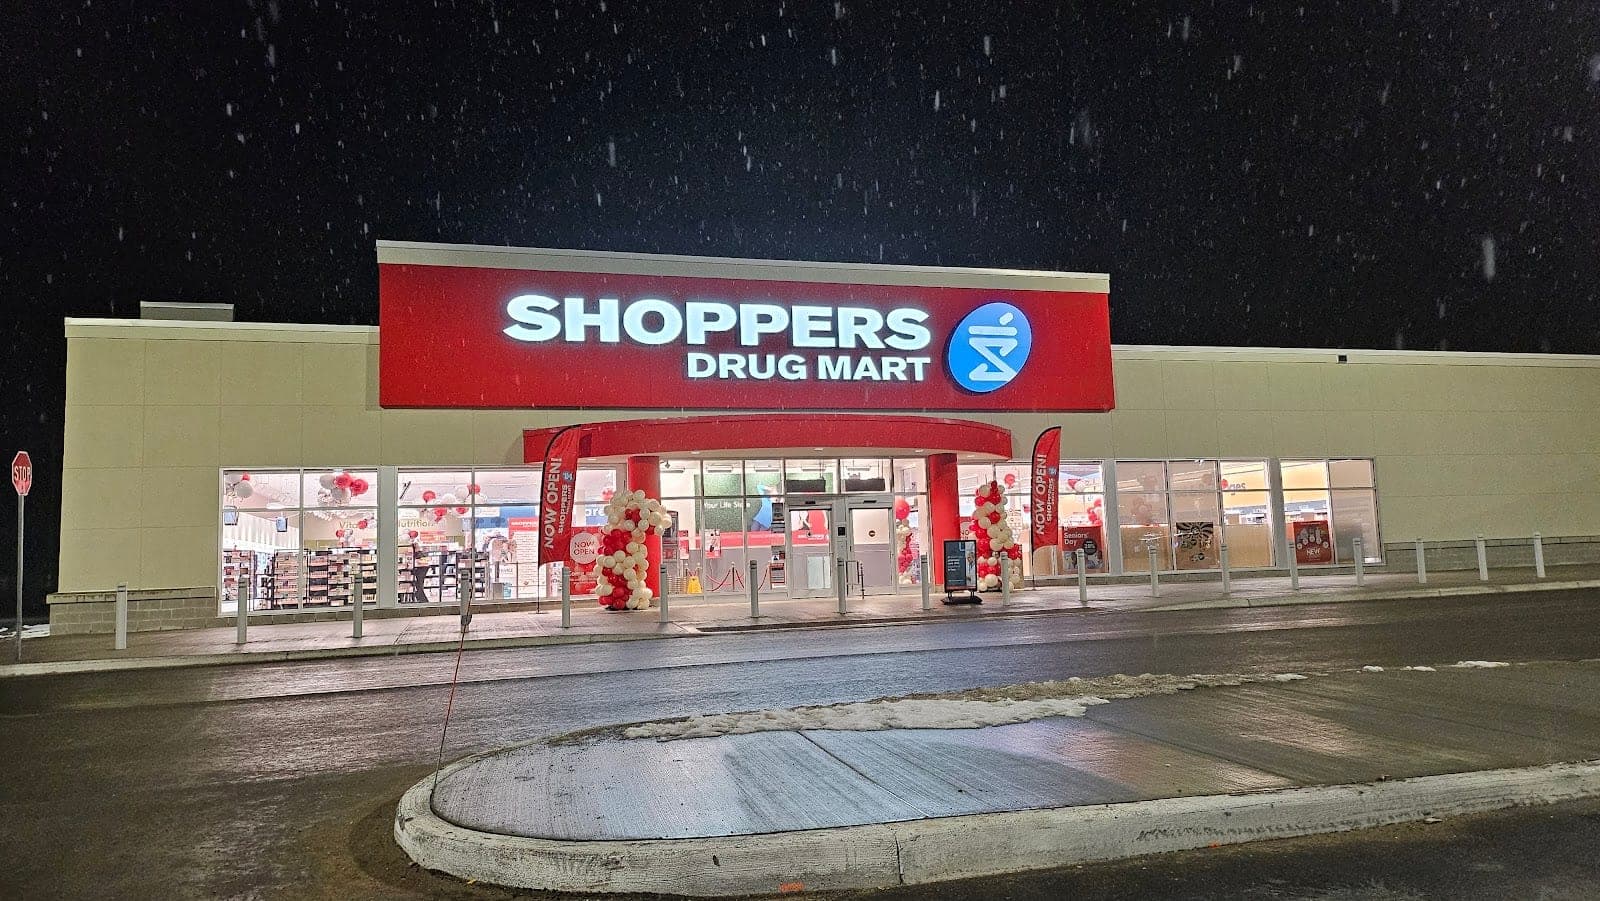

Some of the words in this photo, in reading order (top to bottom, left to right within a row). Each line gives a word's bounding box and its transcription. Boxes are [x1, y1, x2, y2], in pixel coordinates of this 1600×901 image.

[503, 294, 931, 351] SHOPPERS
[687, 352, 805, 381] DRUG
[817, 354, 931, 382] MART
[14, 465, 31, 481] STOP
[547, 458, 561, 503] OPEN!
[1035, 454, 1047, 495] OPEN!
[543, 507, 557, 549] NOW
[557, 484, 568, 535] SHOPPERS
[1035, 498, 1046, 535] NOW
[1064, 539, 1077, 547] Day
